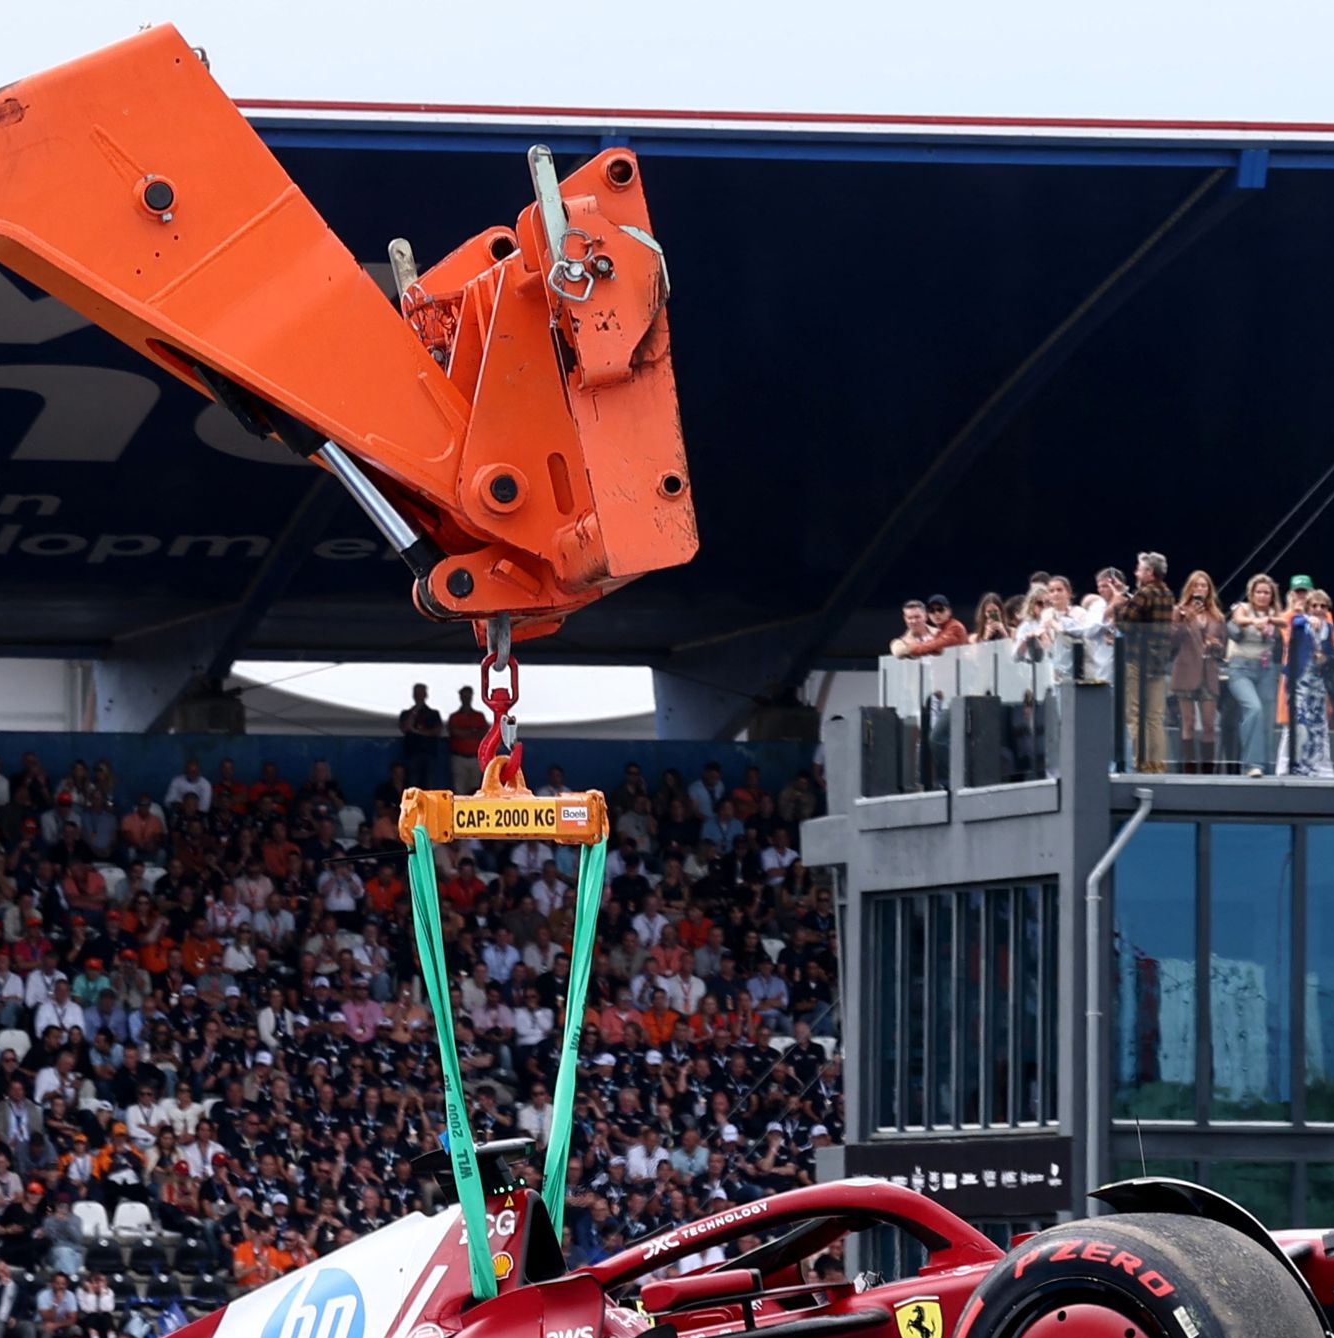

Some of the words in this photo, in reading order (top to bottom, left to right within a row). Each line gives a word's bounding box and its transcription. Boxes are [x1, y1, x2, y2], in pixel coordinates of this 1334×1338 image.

[456, 809, 490, 828] CAP:
[495, 809, 530, 828] 2000
[534, 808, 555, 827] KG
[562, 808, 587, 819] Boels
[447, 1103, 464, 1138] 2000
[681, 1201, 769, 1239] TECHNOLOGY
[1014, 1249, 1041, 1279] P
[1049, 1239, 1176, 1298] ZERO
